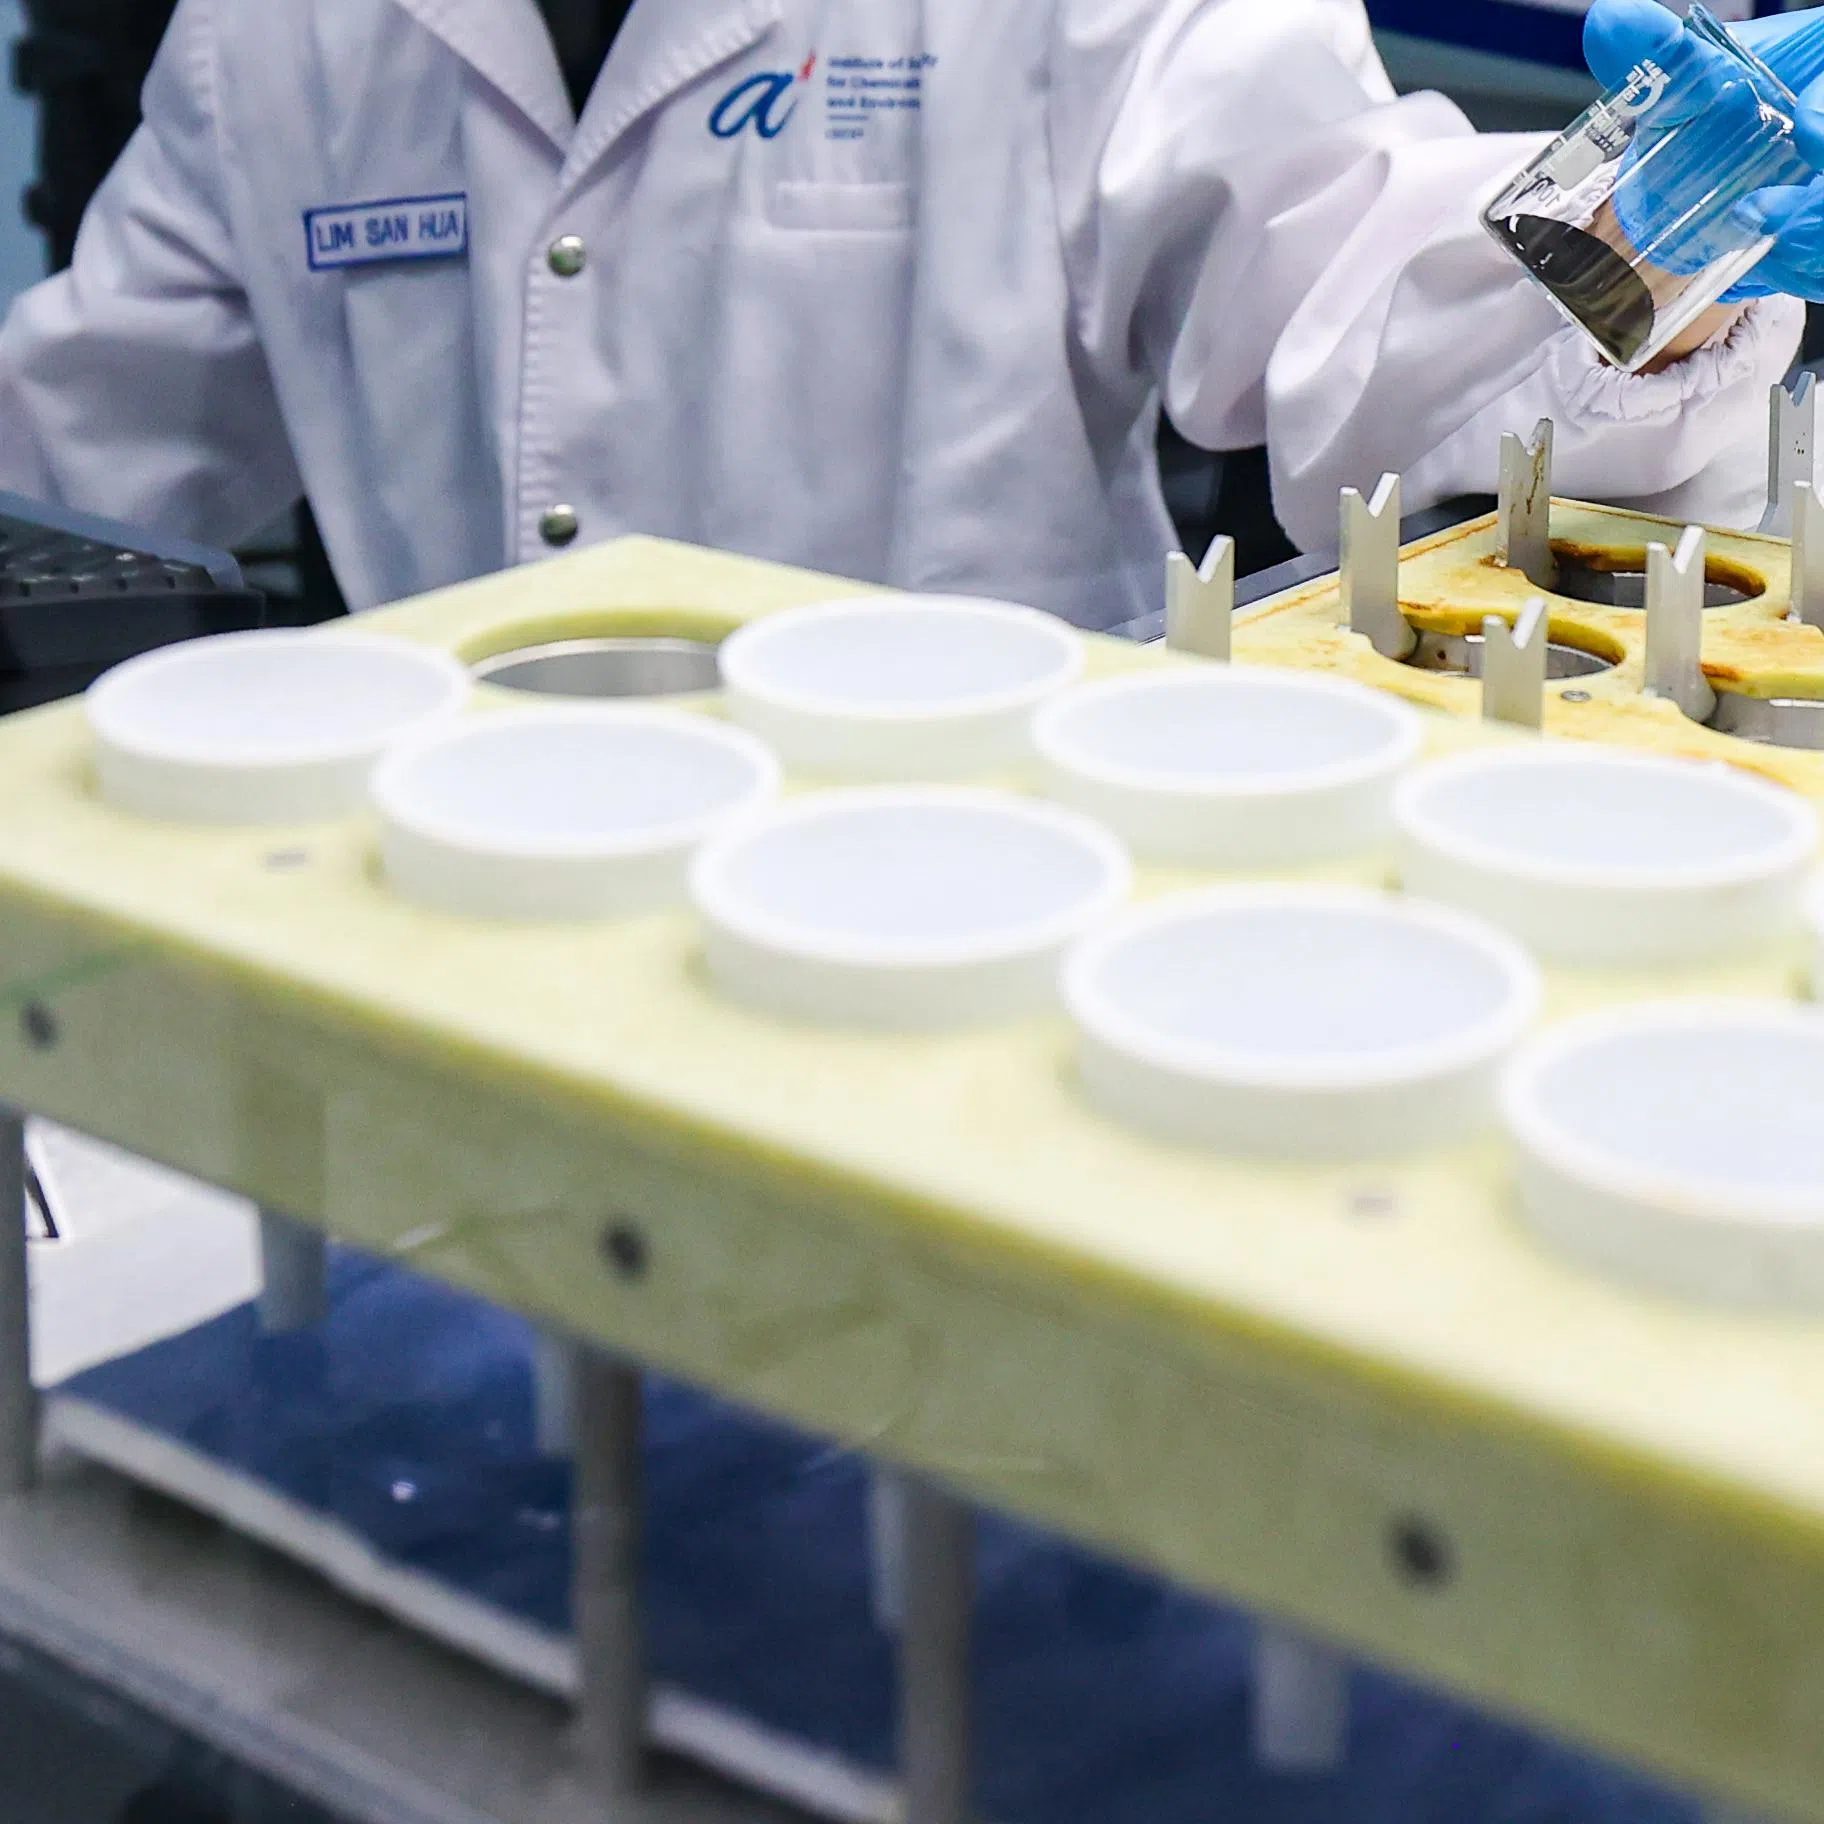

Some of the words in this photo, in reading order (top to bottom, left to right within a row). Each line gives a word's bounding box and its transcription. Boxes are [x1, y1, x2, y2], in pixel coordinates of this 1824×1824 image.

[316, 221, 354, 252] LIM
[366, 213, 408, 246] SAN
[419, 209, 459, 240] HUA
